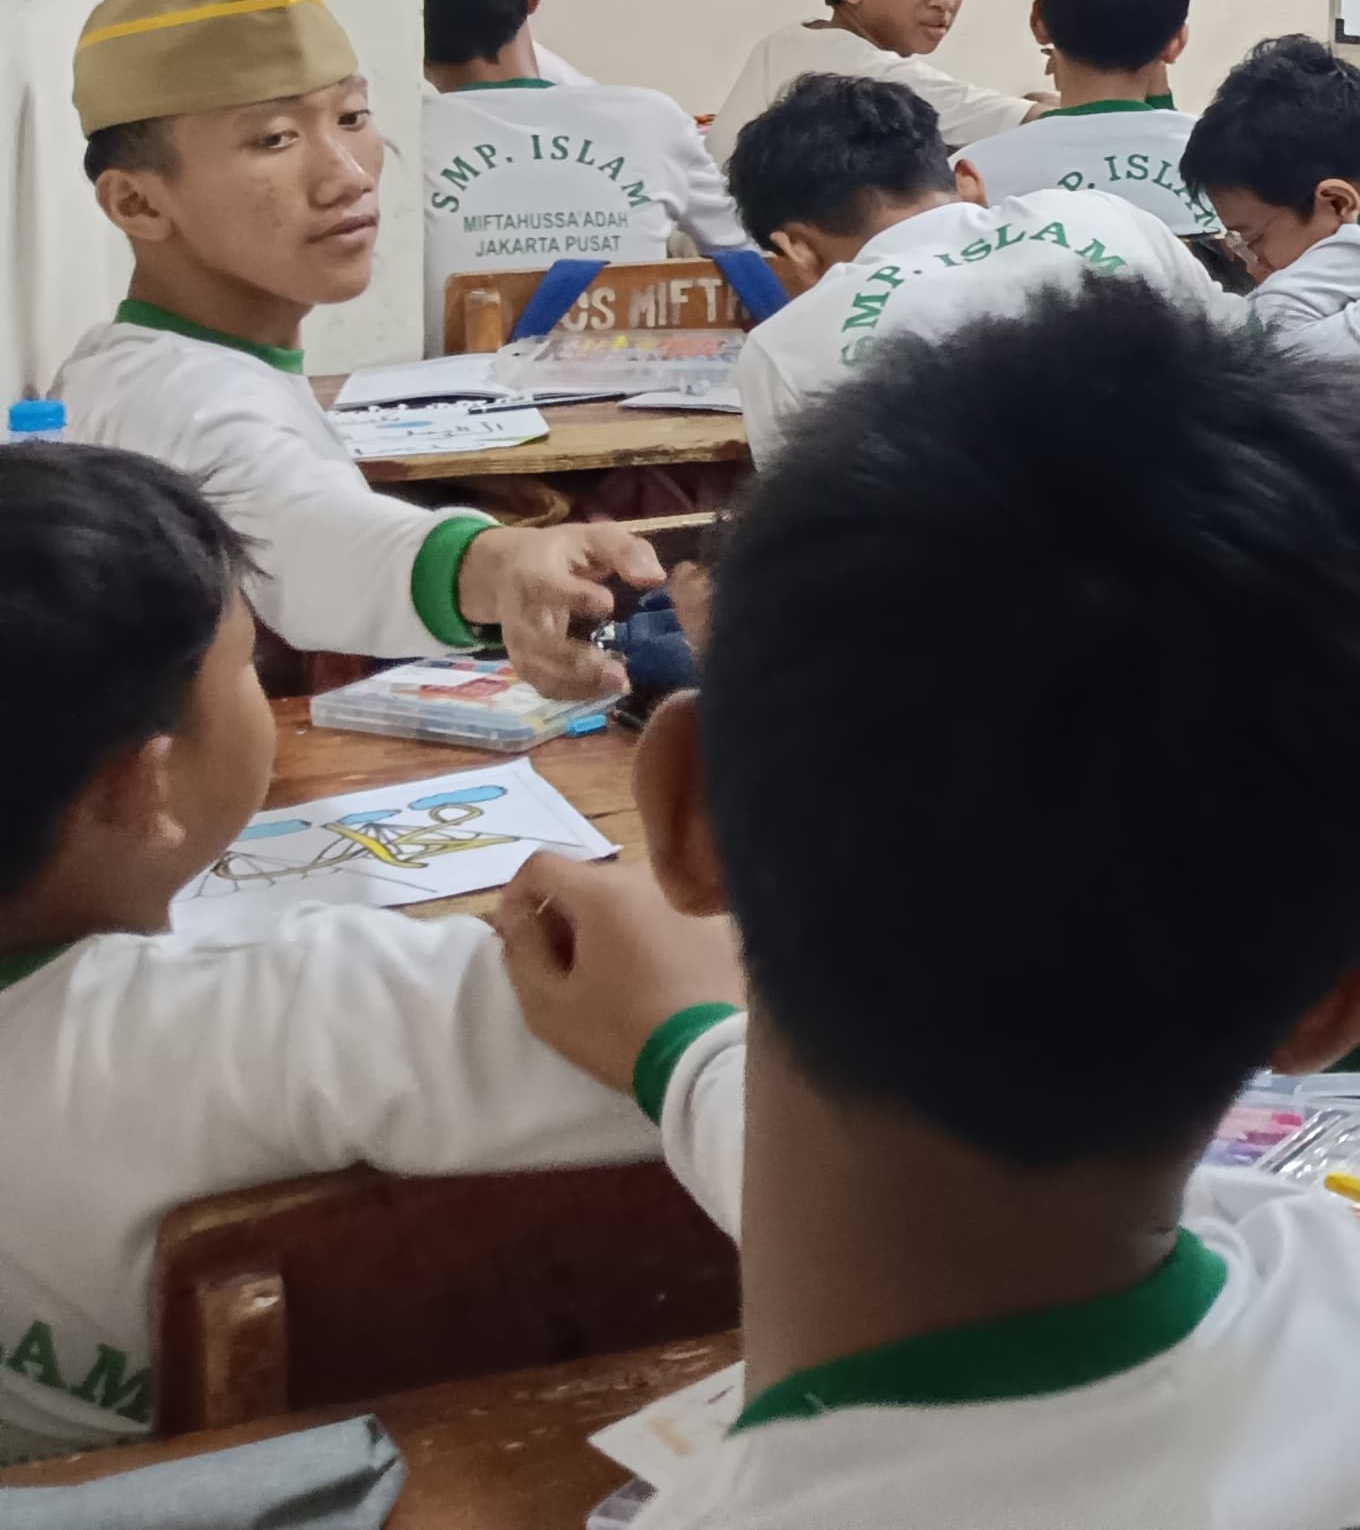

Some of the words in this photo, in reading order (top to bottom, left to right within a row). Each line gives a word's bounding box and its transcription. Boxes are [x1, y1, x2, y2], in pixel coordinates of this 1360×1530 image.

[431, 141, 513, 214] SMP.
[530, 134, 652, 208] ISLAM
[463, 211, 630, 234] MIFTAHUSSA'ADAH
[476, 236, 560, 258] JAKARTA
[565, 234, 622, 254] PUSAT
[934, 221, 1129, 272] ISLAM
